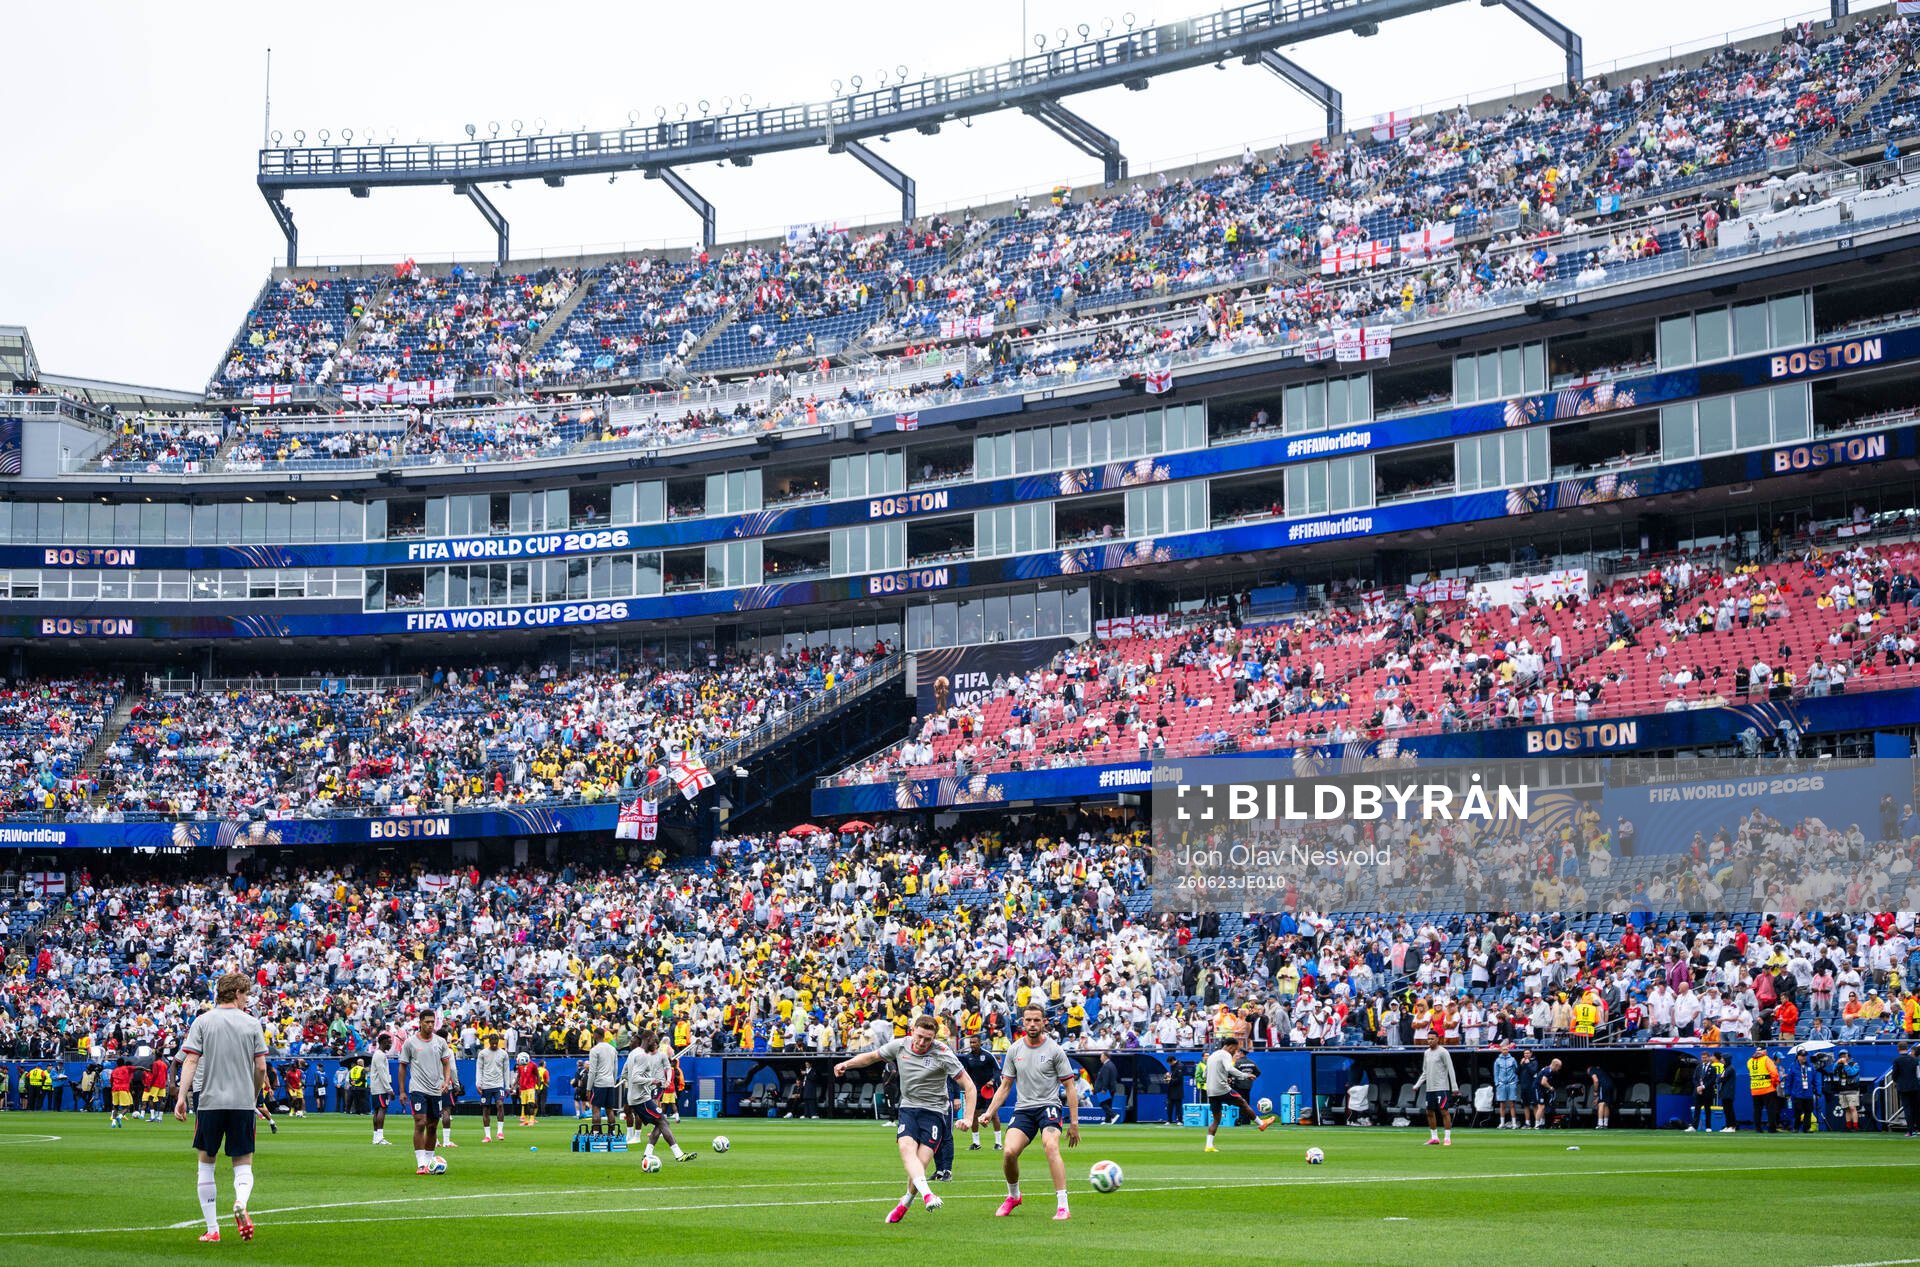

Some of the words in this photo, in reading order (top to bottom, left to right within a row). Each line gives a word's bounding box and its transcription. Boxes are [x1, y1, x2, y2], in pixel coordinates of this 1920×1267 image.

[1772, 339, 1882, 378] BOSTON
[1287, 432, 1371, 457] #FIFAWorldCup
[1774, 436, 1885, 472] BOSTON
[869, 491, 948, 518] BOSTON
[1288, 517, 1373, 541] #FIFAWorldCup
[408, 542, 449, 560] FIFA
[452, 539, 523, 558] WORLD
[525, 536, 562, 554] CUP
[564, 529, 629, 551] 2026
[44, 549, 136, 565] BOSTON
[869, 568, 948, 594] BOSTON
[42, 618, 133, 635] BOSTON
[406, 613, 448, 630] FIFA
[450, 610, 522, 628] WORLD
[523, 607, 561, 625] CUP
[563, 602, 628, 622] 2026
[954, 671, 990, 689] FIFA
[954, 690, 993, 707] WOR
[1527, 721, 1637, 753] BOSTON
[1099, 765, 1183, 788] #FIFAWorldCup
[1649, 787, 1681, 803] FIFA
[1682, 784, 1736, 800] WORLD
[1737, 781, 1768, 797] CUP
[1770, 776, 1825, 795] 2026
[370, 818, 450, 838] BOSTON
[1045, 1107, 1058, 1119] 14
[931, 1125, 938, 1140] 8
